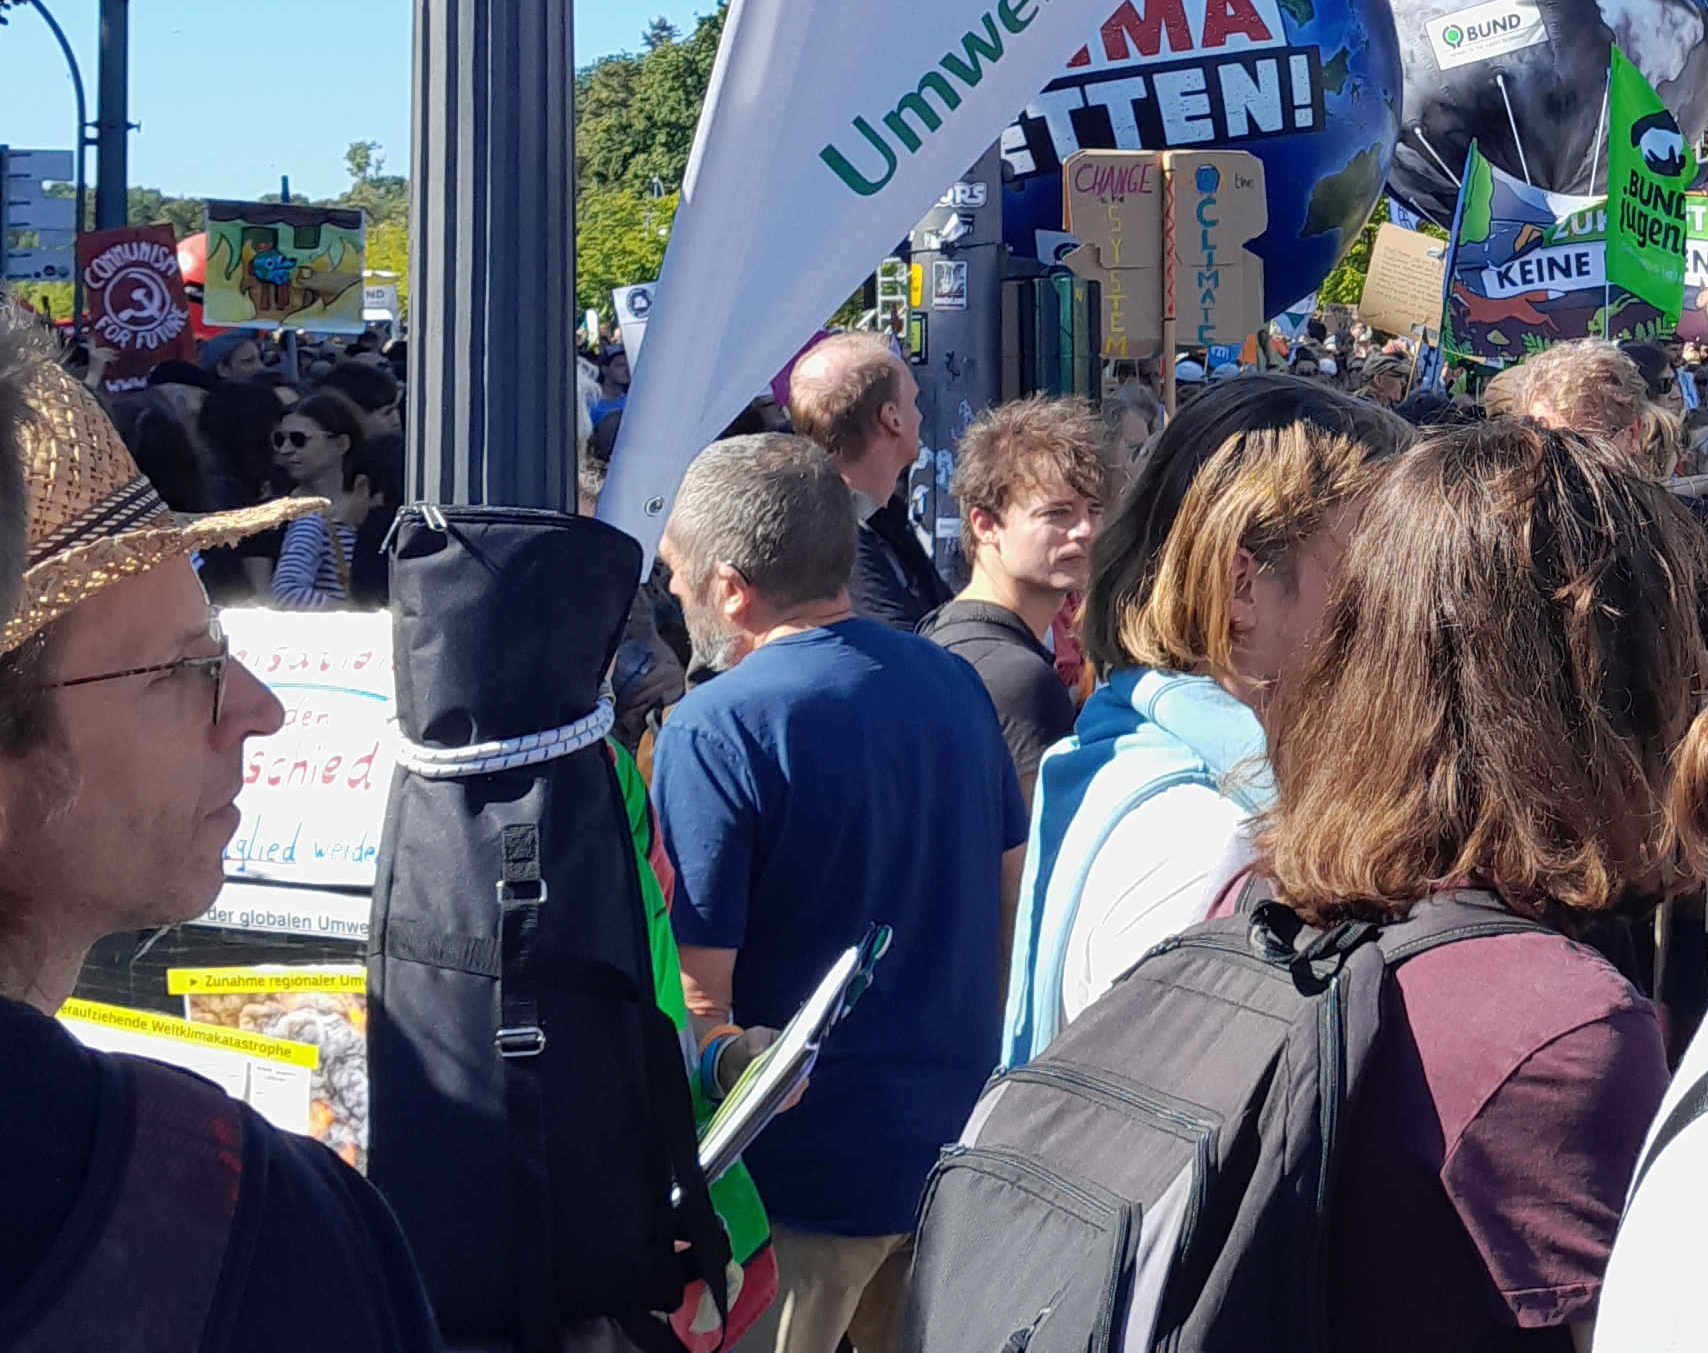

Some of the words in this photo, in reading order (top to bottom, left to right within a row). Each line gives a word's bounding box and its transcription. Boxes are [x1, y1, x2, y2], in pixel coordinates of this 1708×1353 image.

[1467, 14, 1521, 42] BUND
[1075, 164, 1154, 193] CHANGE
[1234, 173, 1256, 189] the
[1629, 169, 1687, 221] BUND
[1619, 185, 1687, 257] jugen
[84, 240, 178, 289] COMMUNISM
[1104, 206, 1128, 356] SYSTEM
[1196, 198, 1220, 346] CLIMATE
[1497, 251, 1590, 289] KEINE
[94, 315, 131, 348] FOR
[135, 303, 189, 350] FUTURE
[223, 814, 303, 873] glied
[314, 832, 378, 864] werde
[207, 905, 234, 922] der
[239, 909, 312, 929] globalen
[318, 915, 369, 934] Umwe
[205, 974, 265, 987] Zunahme
[269, 974, 336, 989] regionaler
[151, 1019, 293, 1059] Weltklimakatastrophe
